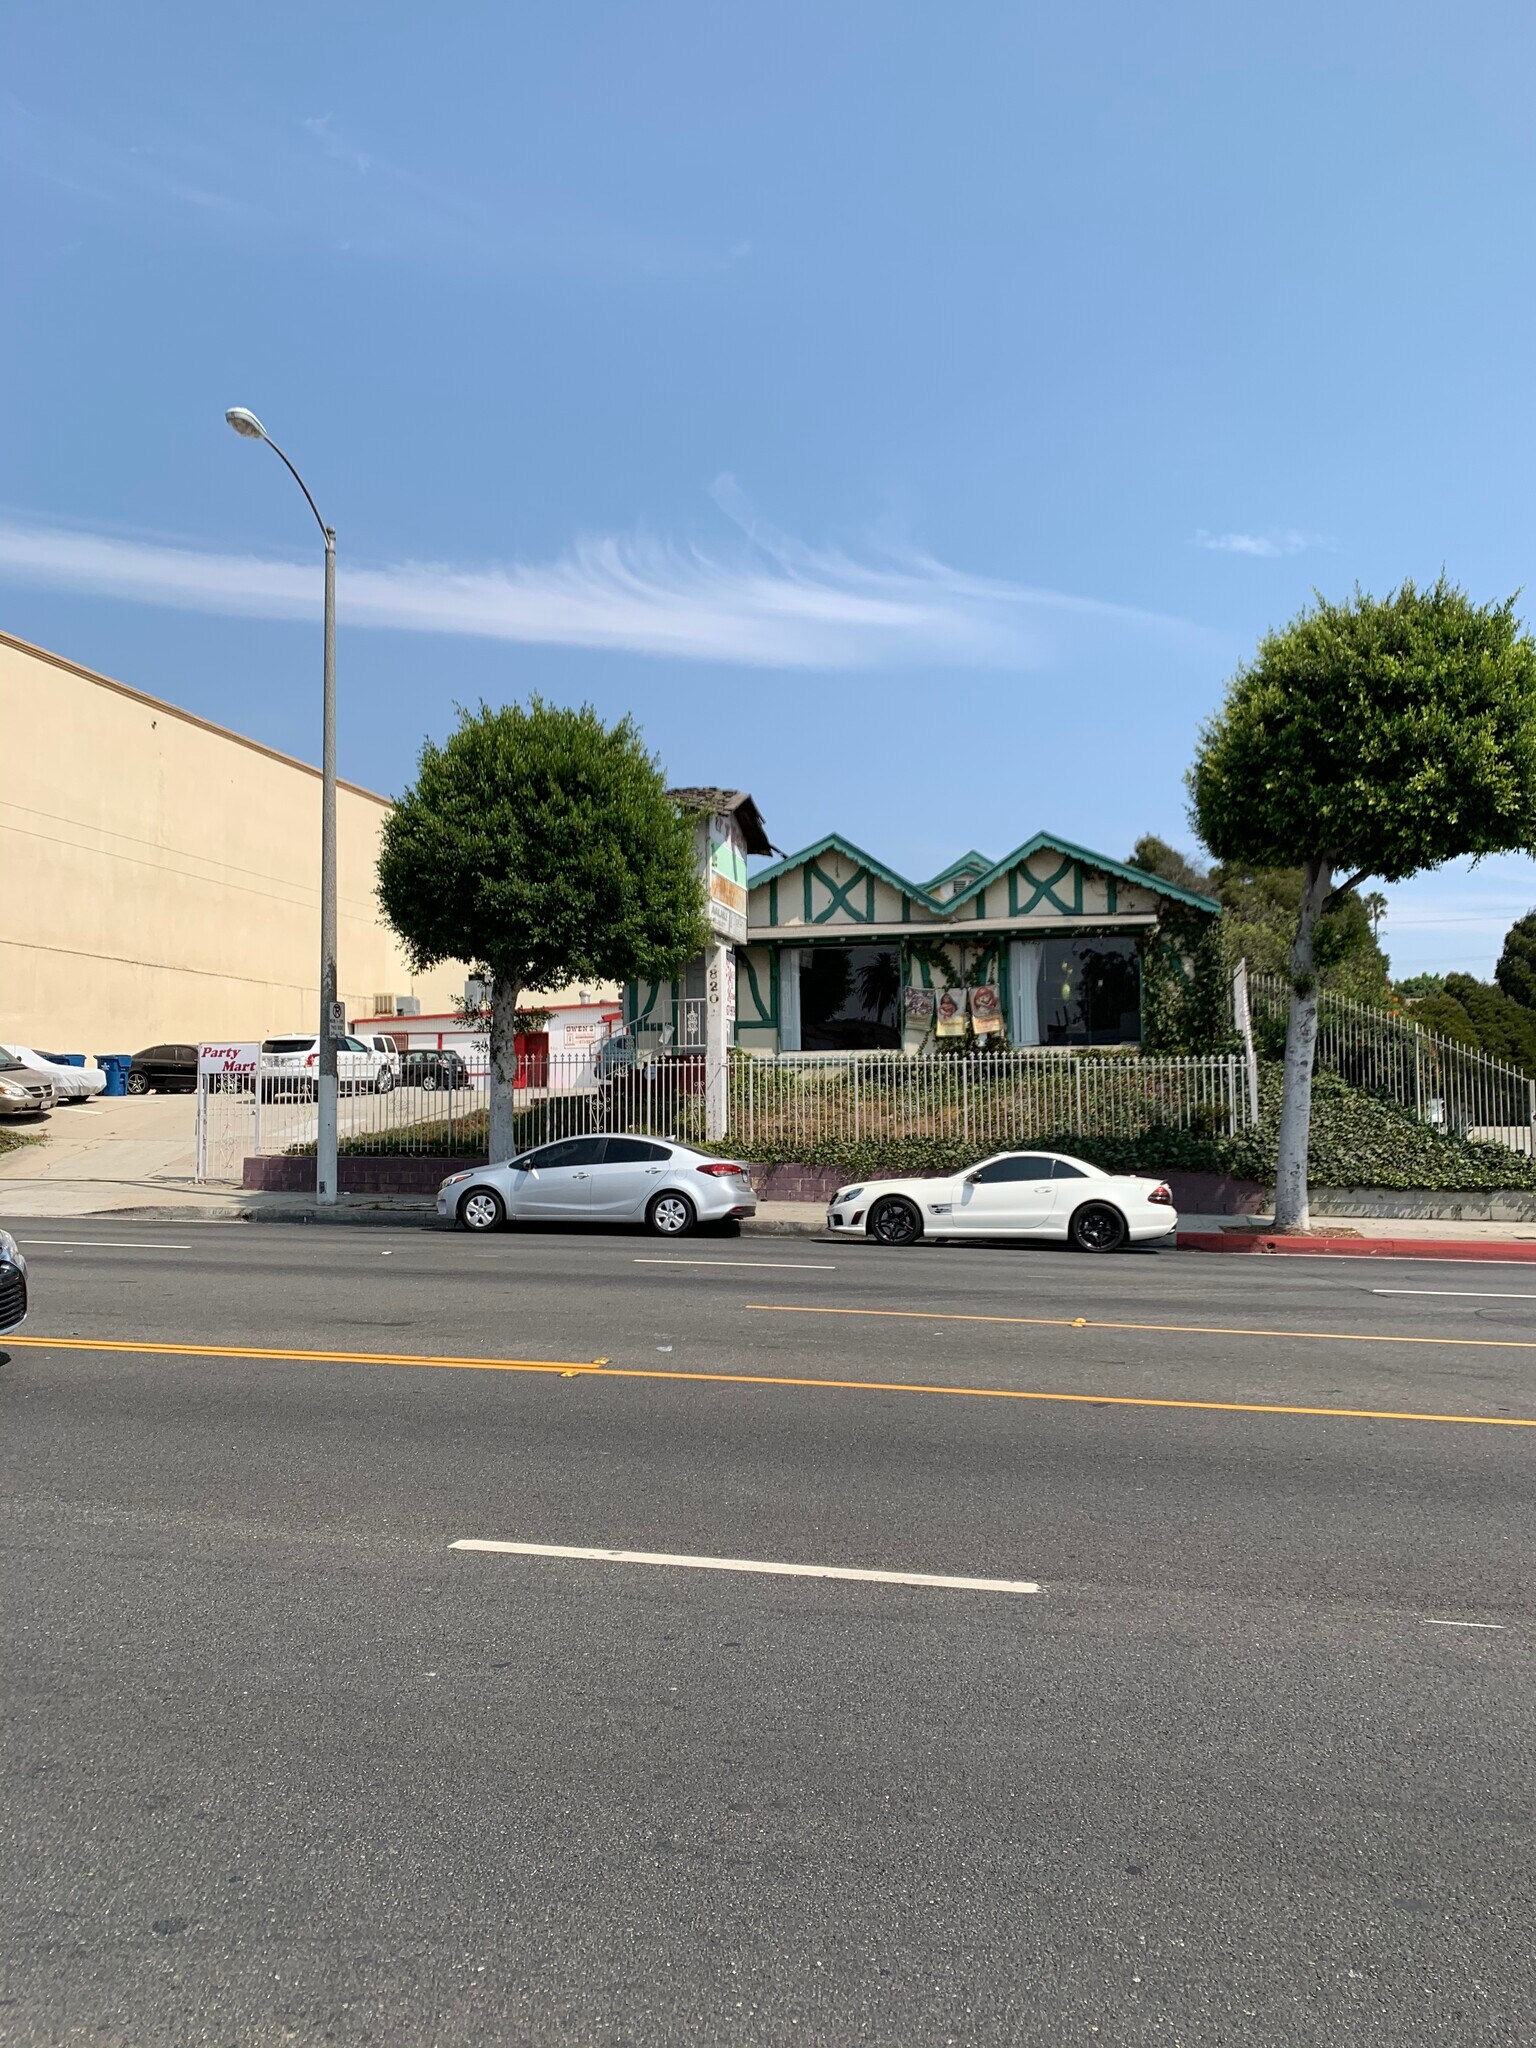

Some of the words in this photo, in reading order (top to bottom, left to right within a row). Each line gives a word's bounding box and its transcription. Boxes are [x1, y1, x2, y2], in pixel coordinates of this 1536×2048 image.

[709, 968, 719, 1004] 820
[201, 1047, 241, 1059] Party
[222, 1061, 256, 1072] Mart
